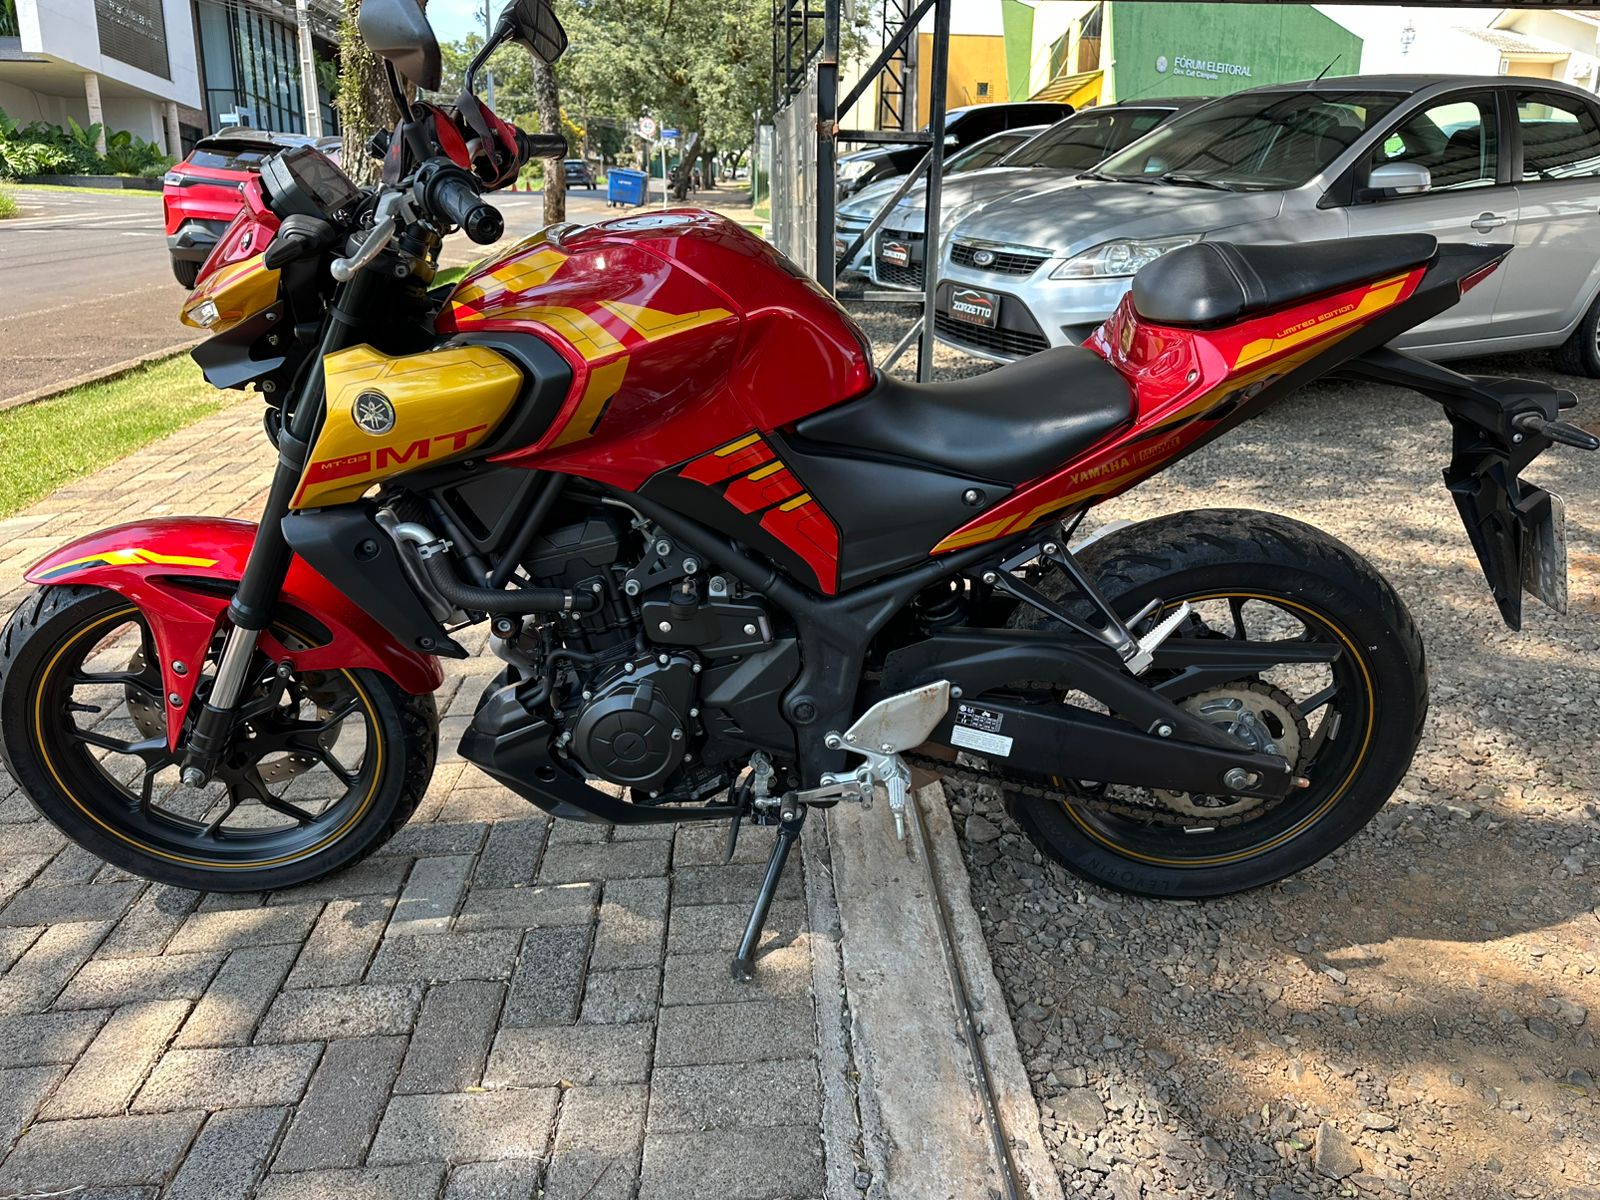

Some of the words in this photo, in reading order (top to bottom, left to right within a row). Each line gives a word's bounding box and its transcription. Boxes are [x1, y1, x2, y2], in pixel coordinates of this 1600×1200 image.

[1174, 55, 1206, 70] FÓRUM
[1207, 61, 1252, 77] ELEITORAL
[953, 300, 992, 318] ZORZETTO
[1276, 318, 1316, 338] LIMITED
[1317, 303, 1355, 322] EDITION
[321, 455, 368, 471] MT-03
[376, 424, 488, 470] MT
[1070, 457, 1130, 485] YAMAHA
[1087, 856, 1171, 890] LEVORIN
